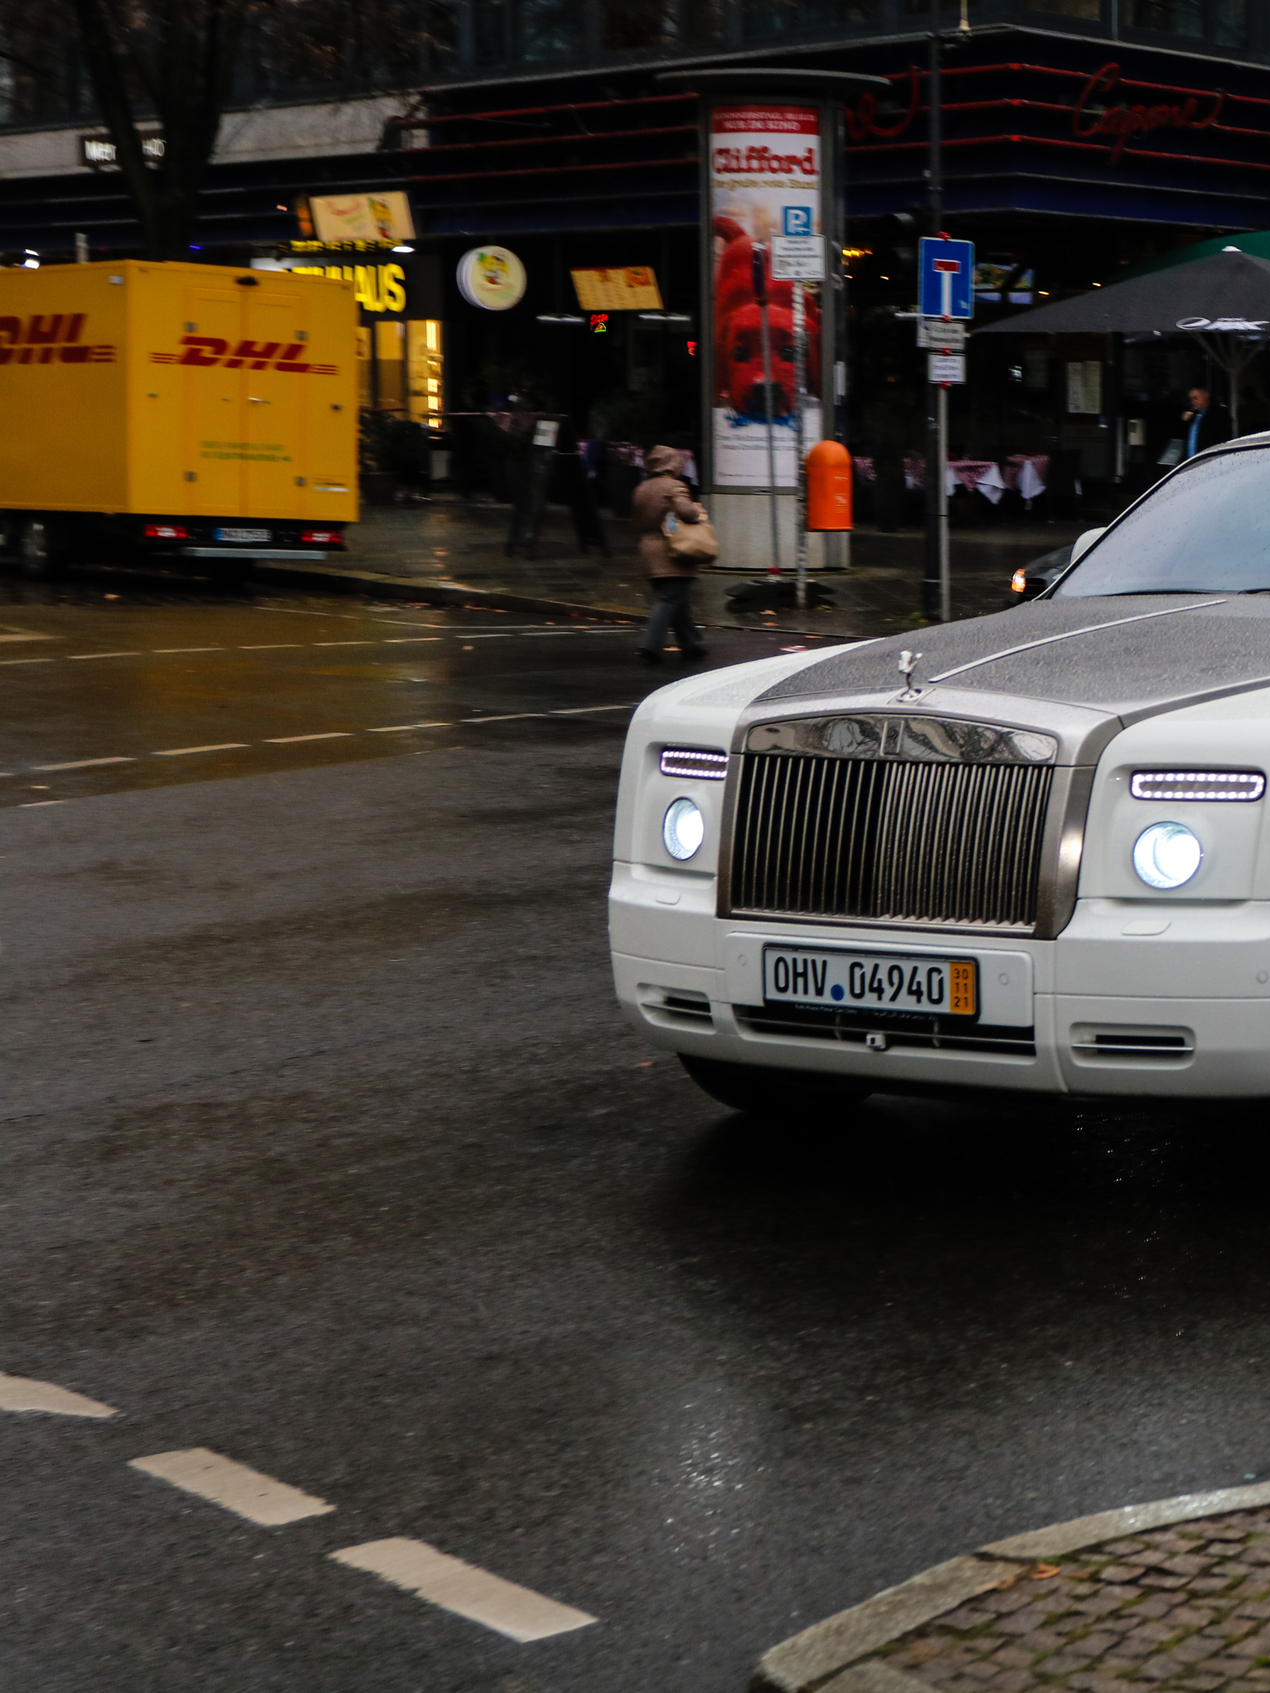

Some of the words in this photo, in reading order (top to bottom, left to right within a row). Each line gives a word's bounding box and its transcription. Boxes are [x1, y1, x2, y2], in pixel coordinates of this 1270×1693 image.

[713, 145, 819, 175] Clifford
[179, 335, 313, 374] DHL
[774, 956, 828, 997] OHV
[849, 961, 944, 1005] 04940
[953, 968, 969, 980] 30
[954, 982, 969, 996] 11
[953, 996, 969, 1008] 21
